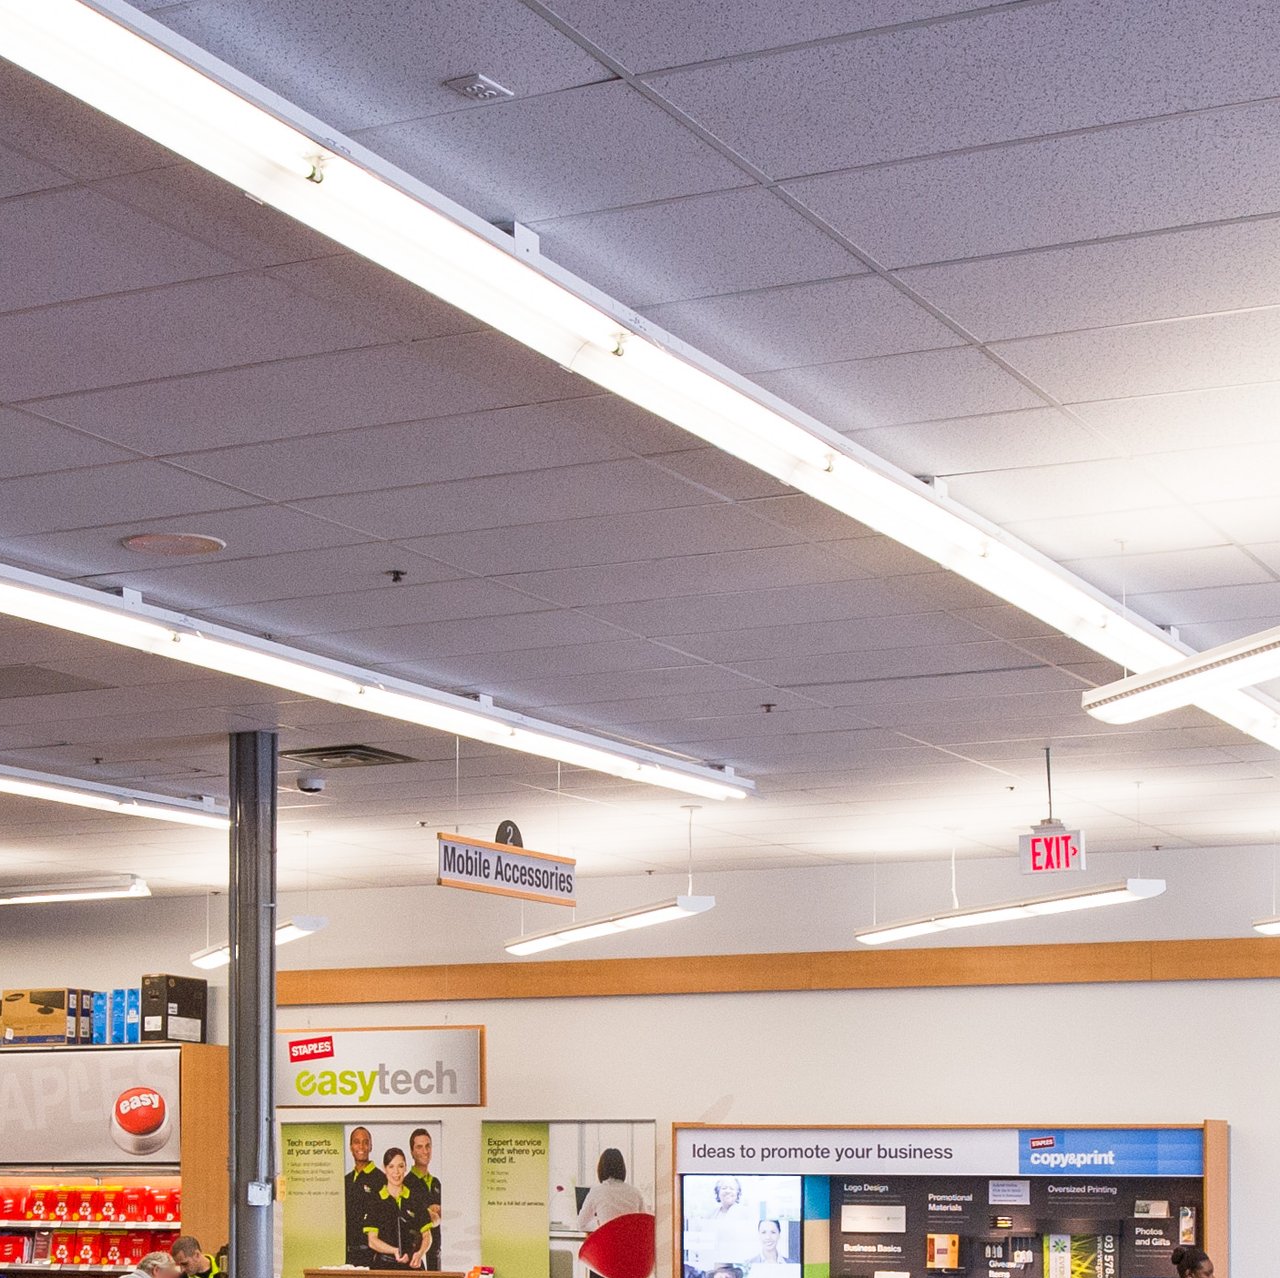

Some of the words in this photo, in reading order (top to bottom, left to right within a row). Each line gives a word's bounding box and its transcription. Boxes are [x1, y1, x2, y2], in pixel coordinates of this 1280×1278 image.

[506, 825, 514, 845] 2
[1031, 835, 1072, 871] EXIT
[443, 845, 490, 880] Mobile
[494, 855, 573, 893] Accessories
[291, 1041, 332, 1057] STAPLES
[295, 1061, 458, 1102] easytech
[119, 1092, 160, 1115] easy
[287, 1139, 303, 1147] Tech
[305, 1139, 332, 1148] experts
[488, 1138, 512, 1148] Expert
[514, 1138, 542, 1146] service
[296, 1148, 311, 1157] your
[488, 1147, 505, 1156] right
[507, 1147, 530, 1155] where
[531, 1148, 546, 1157] you
[692, 1143, 735, 1159] Ideas
[740, 1144, 756, 1159] to
[760, 1144, 830, 1162] promote
[835, 1146, 873, 1162] your
[877, 1144, 953, 1159] business
[488, 1156, 506, 1164] need
[844, 1183, 862, 1193] Logo
[864, 1183, 888, 1193] Design
[1047, 1185, 1086, 1194] Oversized
[1087, 1185, 1118, 1195] Printing
[928, 1193, 972, 1202] Promotional
[928, 1203, 962, 1212] Materials
[1135, 1227, 1163, 1236] Photos
[1135, 1237, 1150, 1246] and
[1151, 1237, 1171, 1246] Gifts
[844, 1243, 876, 1252] Business
[877, 1243, 902, 1252] Basics
